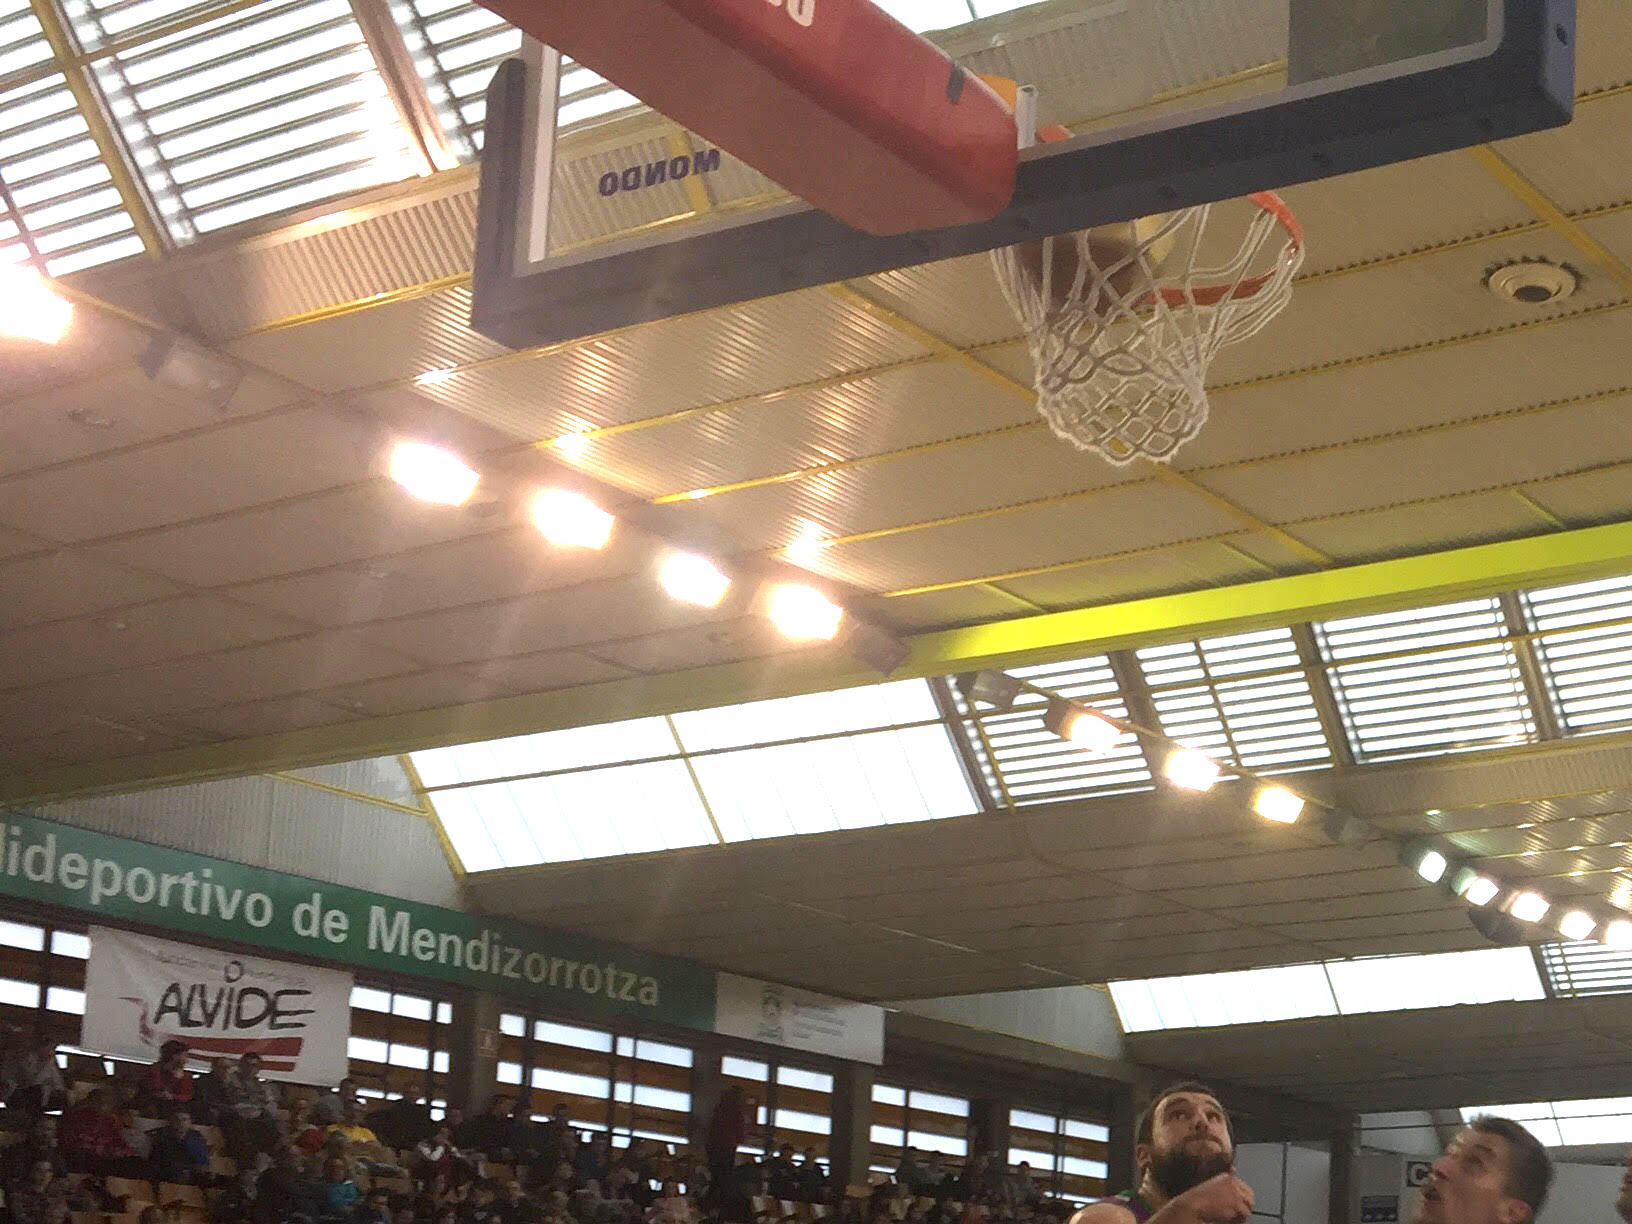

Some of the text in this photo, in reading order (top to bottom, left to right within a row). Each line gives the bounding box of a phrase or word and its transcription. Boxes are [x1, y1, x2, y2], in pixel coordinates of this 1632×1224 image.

[292, 892, 350, 944] de
[367, 904, 660, 1007] Mendizorrotza
[153, 982, 316, 1031] ALVIDE
